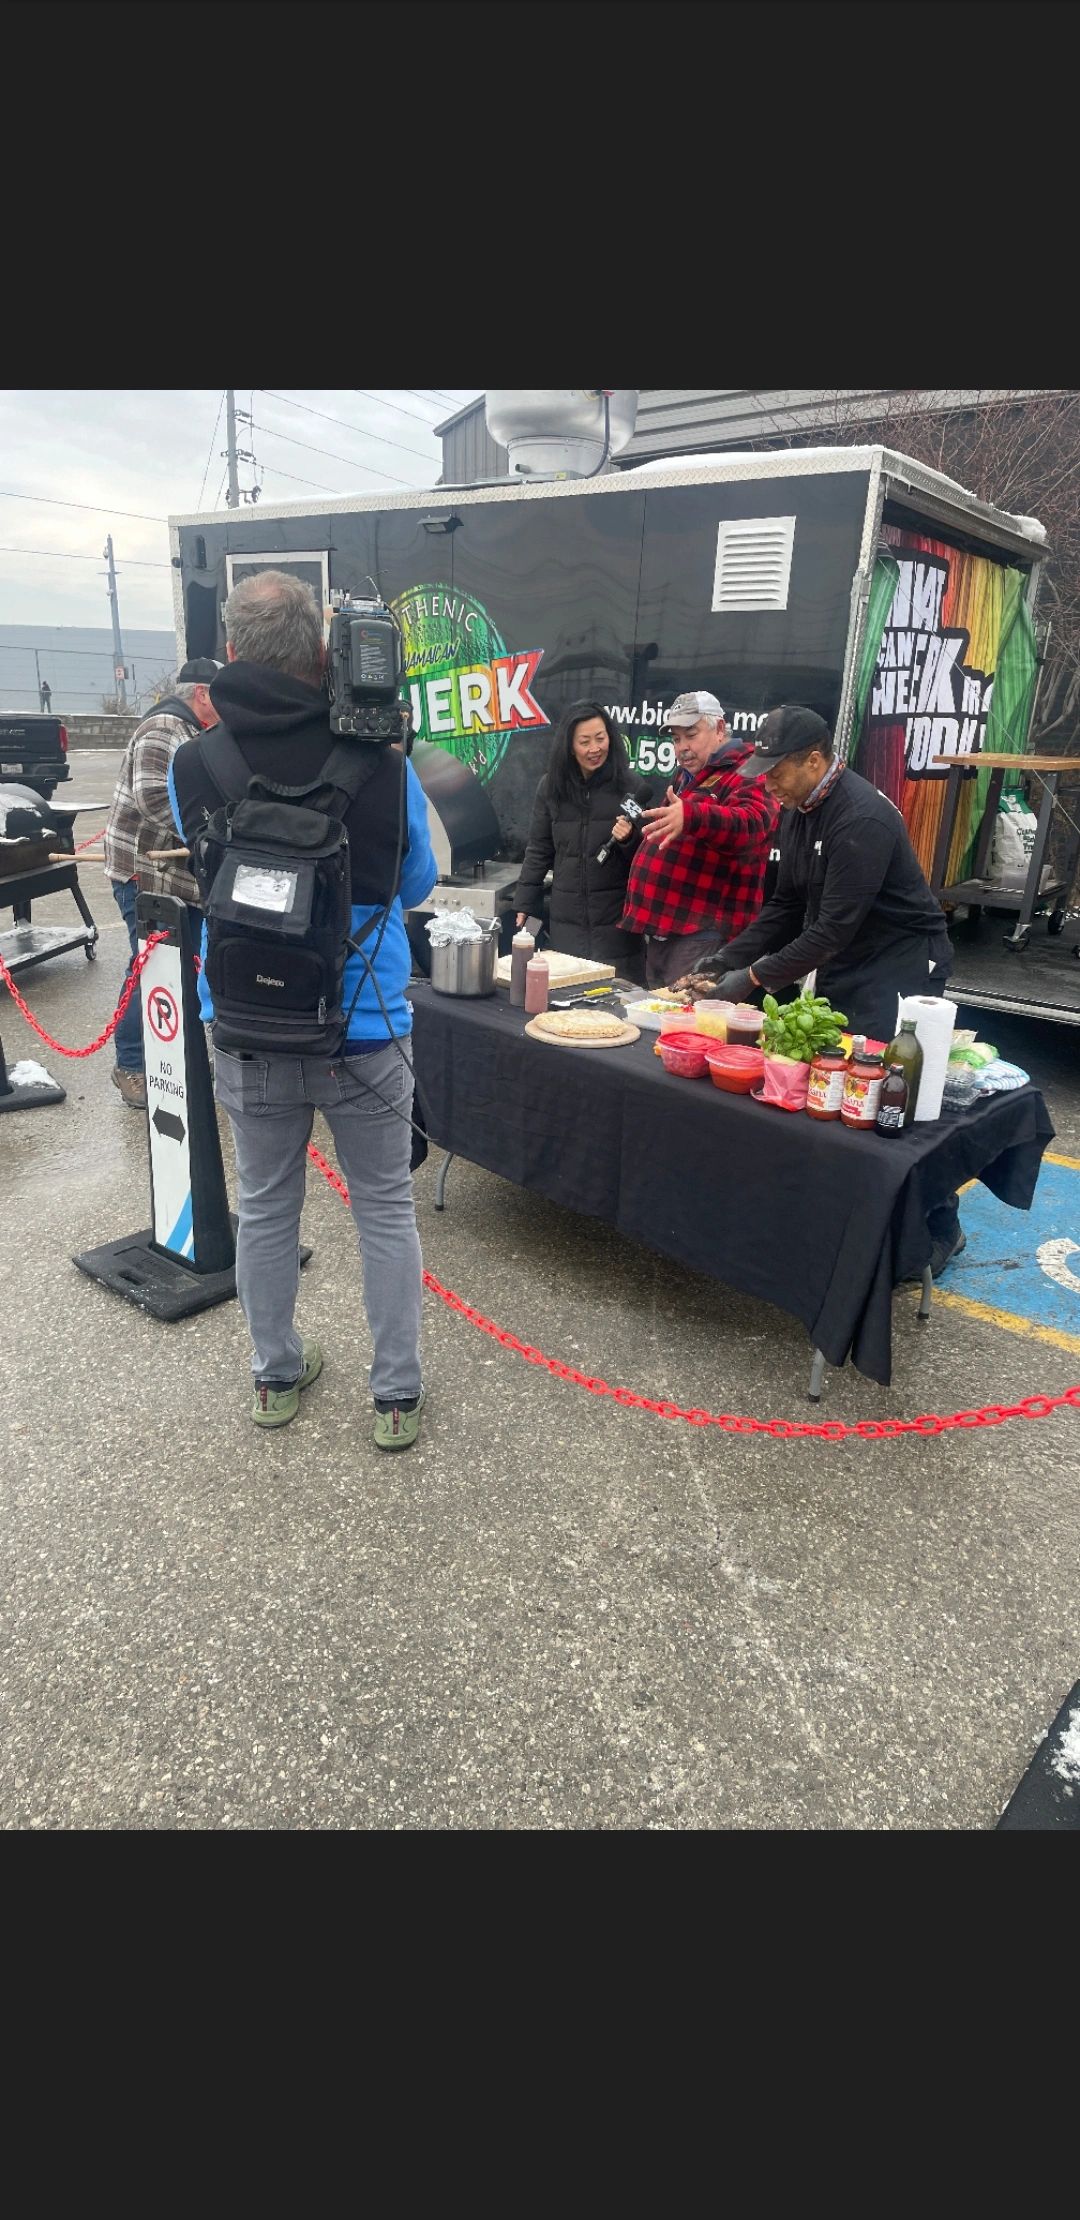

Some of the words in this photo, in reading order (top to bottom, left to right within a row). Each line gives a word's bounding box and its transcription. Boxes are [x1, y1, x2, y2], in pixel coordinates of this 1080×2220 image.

[402, 596, 477, 632] THENIC
[410, 662, 536, 733] JERK
[160, 1060, 172, 1076] NO
[149, 1075, 184, 1099] PARKING
